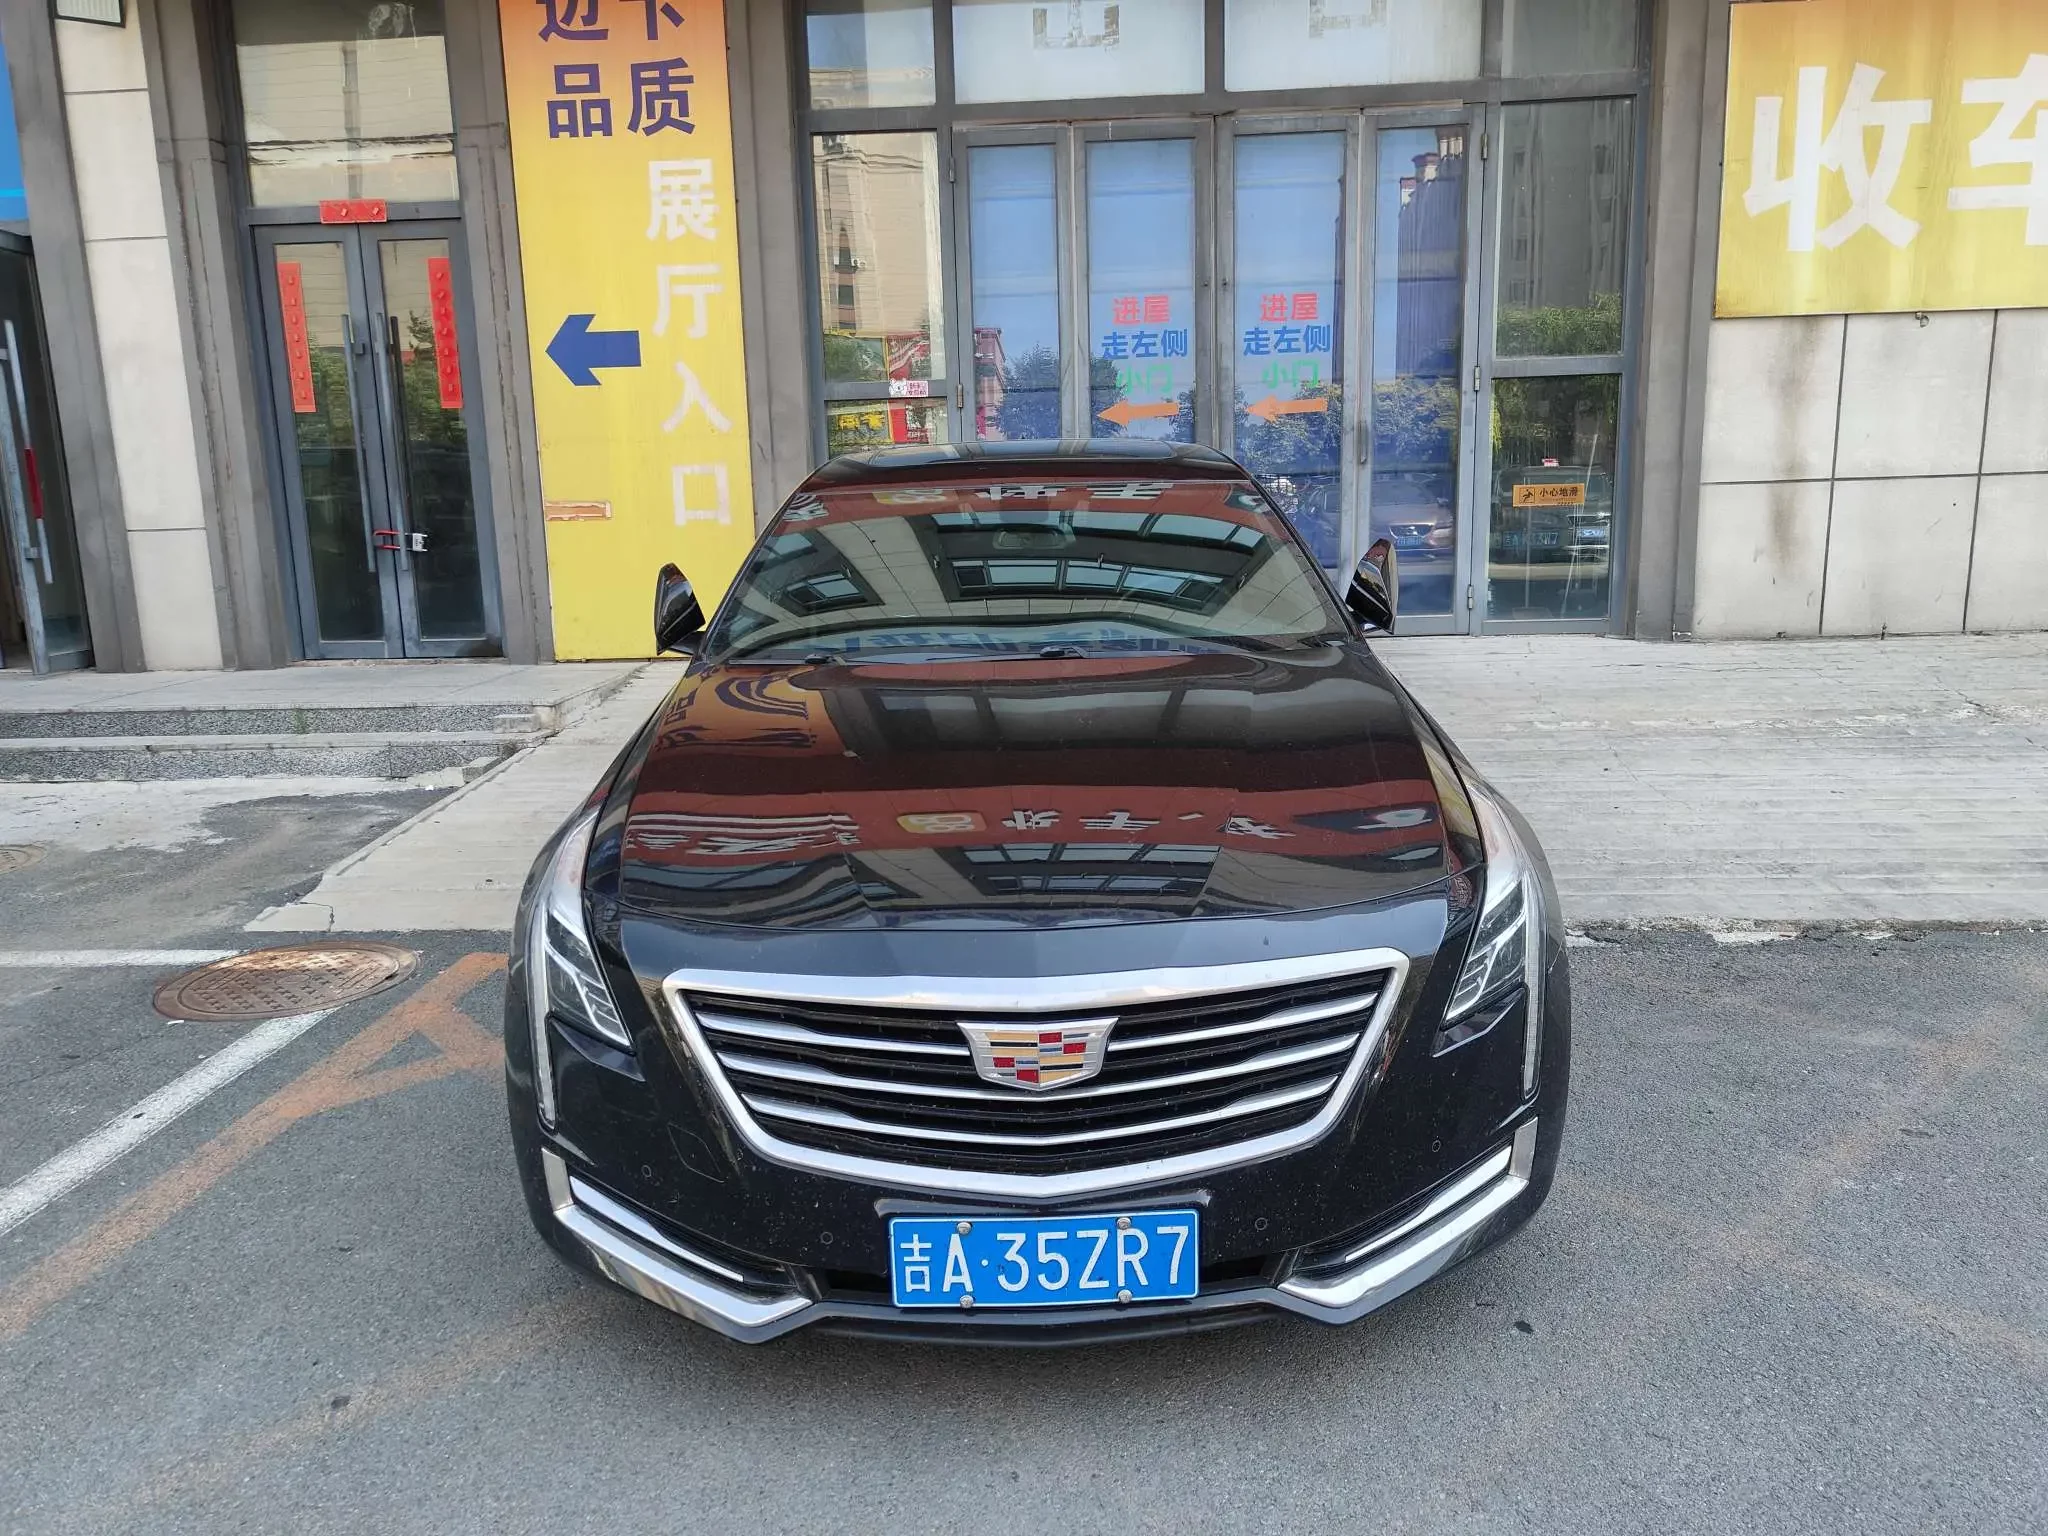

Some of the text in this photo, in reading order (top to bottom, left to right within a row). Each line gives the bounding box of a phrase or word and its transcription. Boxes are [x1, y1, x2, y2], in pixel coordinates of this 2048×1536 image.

[547, 57, 696, 138] 品质
[1112, 294, 1171, 326] 进屋
[1261, 292, 1320, 322] 进屋
[645, 158, 733, 527] 展厅入口
[1100, 328, 1189, 360] 走左侧
[1242, 323, 1332, 357] 走左侧
[1114, 363, 1174, 396] 小门
[1261, 358, 1321, 390] 小门
[900, 1226, 1190, 1292] 吉A·35ZR7
